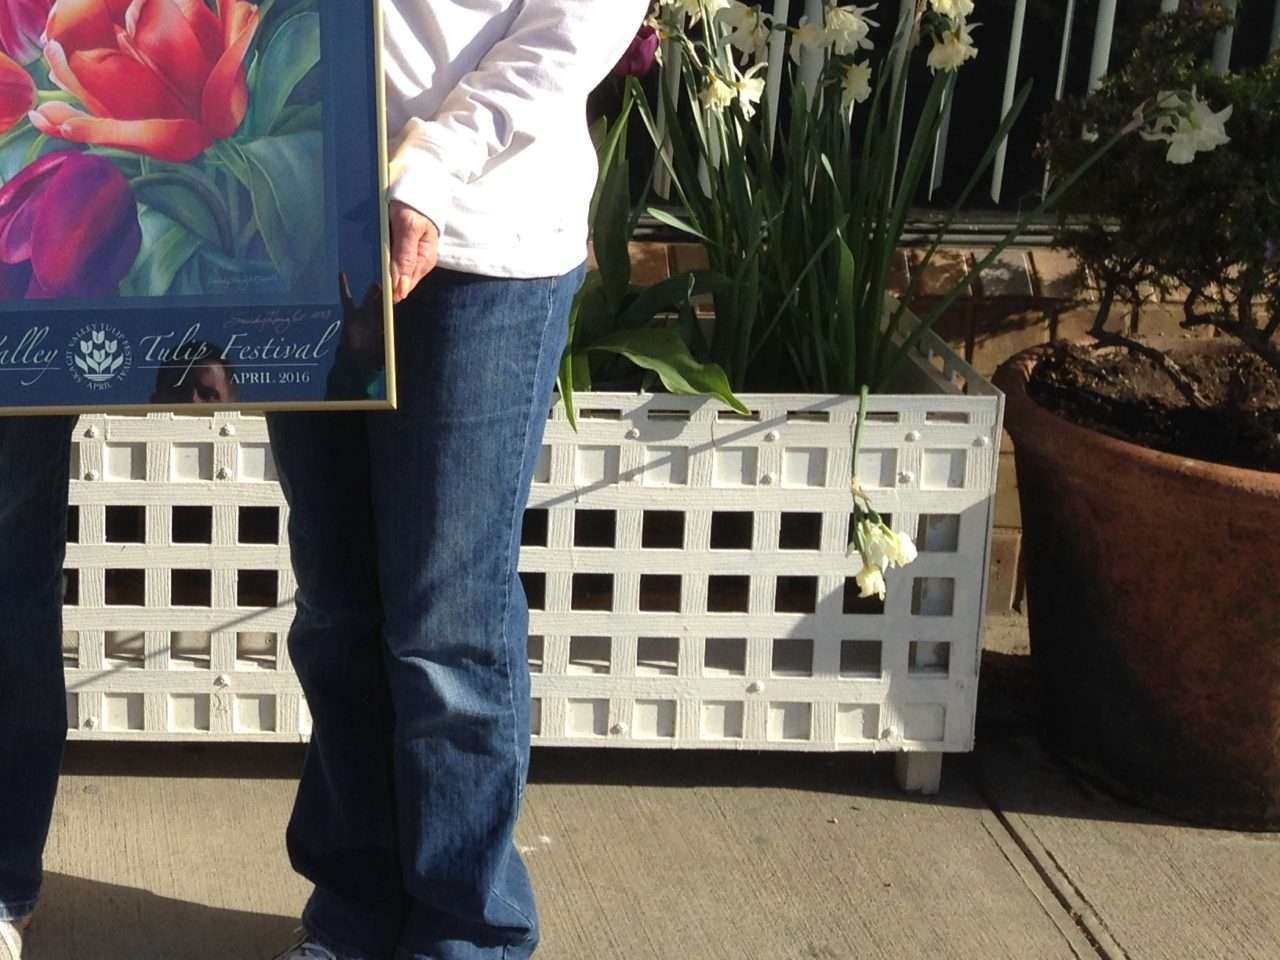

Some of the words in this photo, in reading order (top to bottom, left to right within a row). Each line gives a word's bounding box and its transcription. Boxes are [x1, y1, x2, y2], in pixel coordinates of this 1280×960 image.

[71, 322, 98, 342] VALLEY
[137, 322, 209, 388] Tulip
[219, 319, 342, 363] Festival
[230, 371, 273, 386] APRIL
[278, 371, 311, 385] 2016
